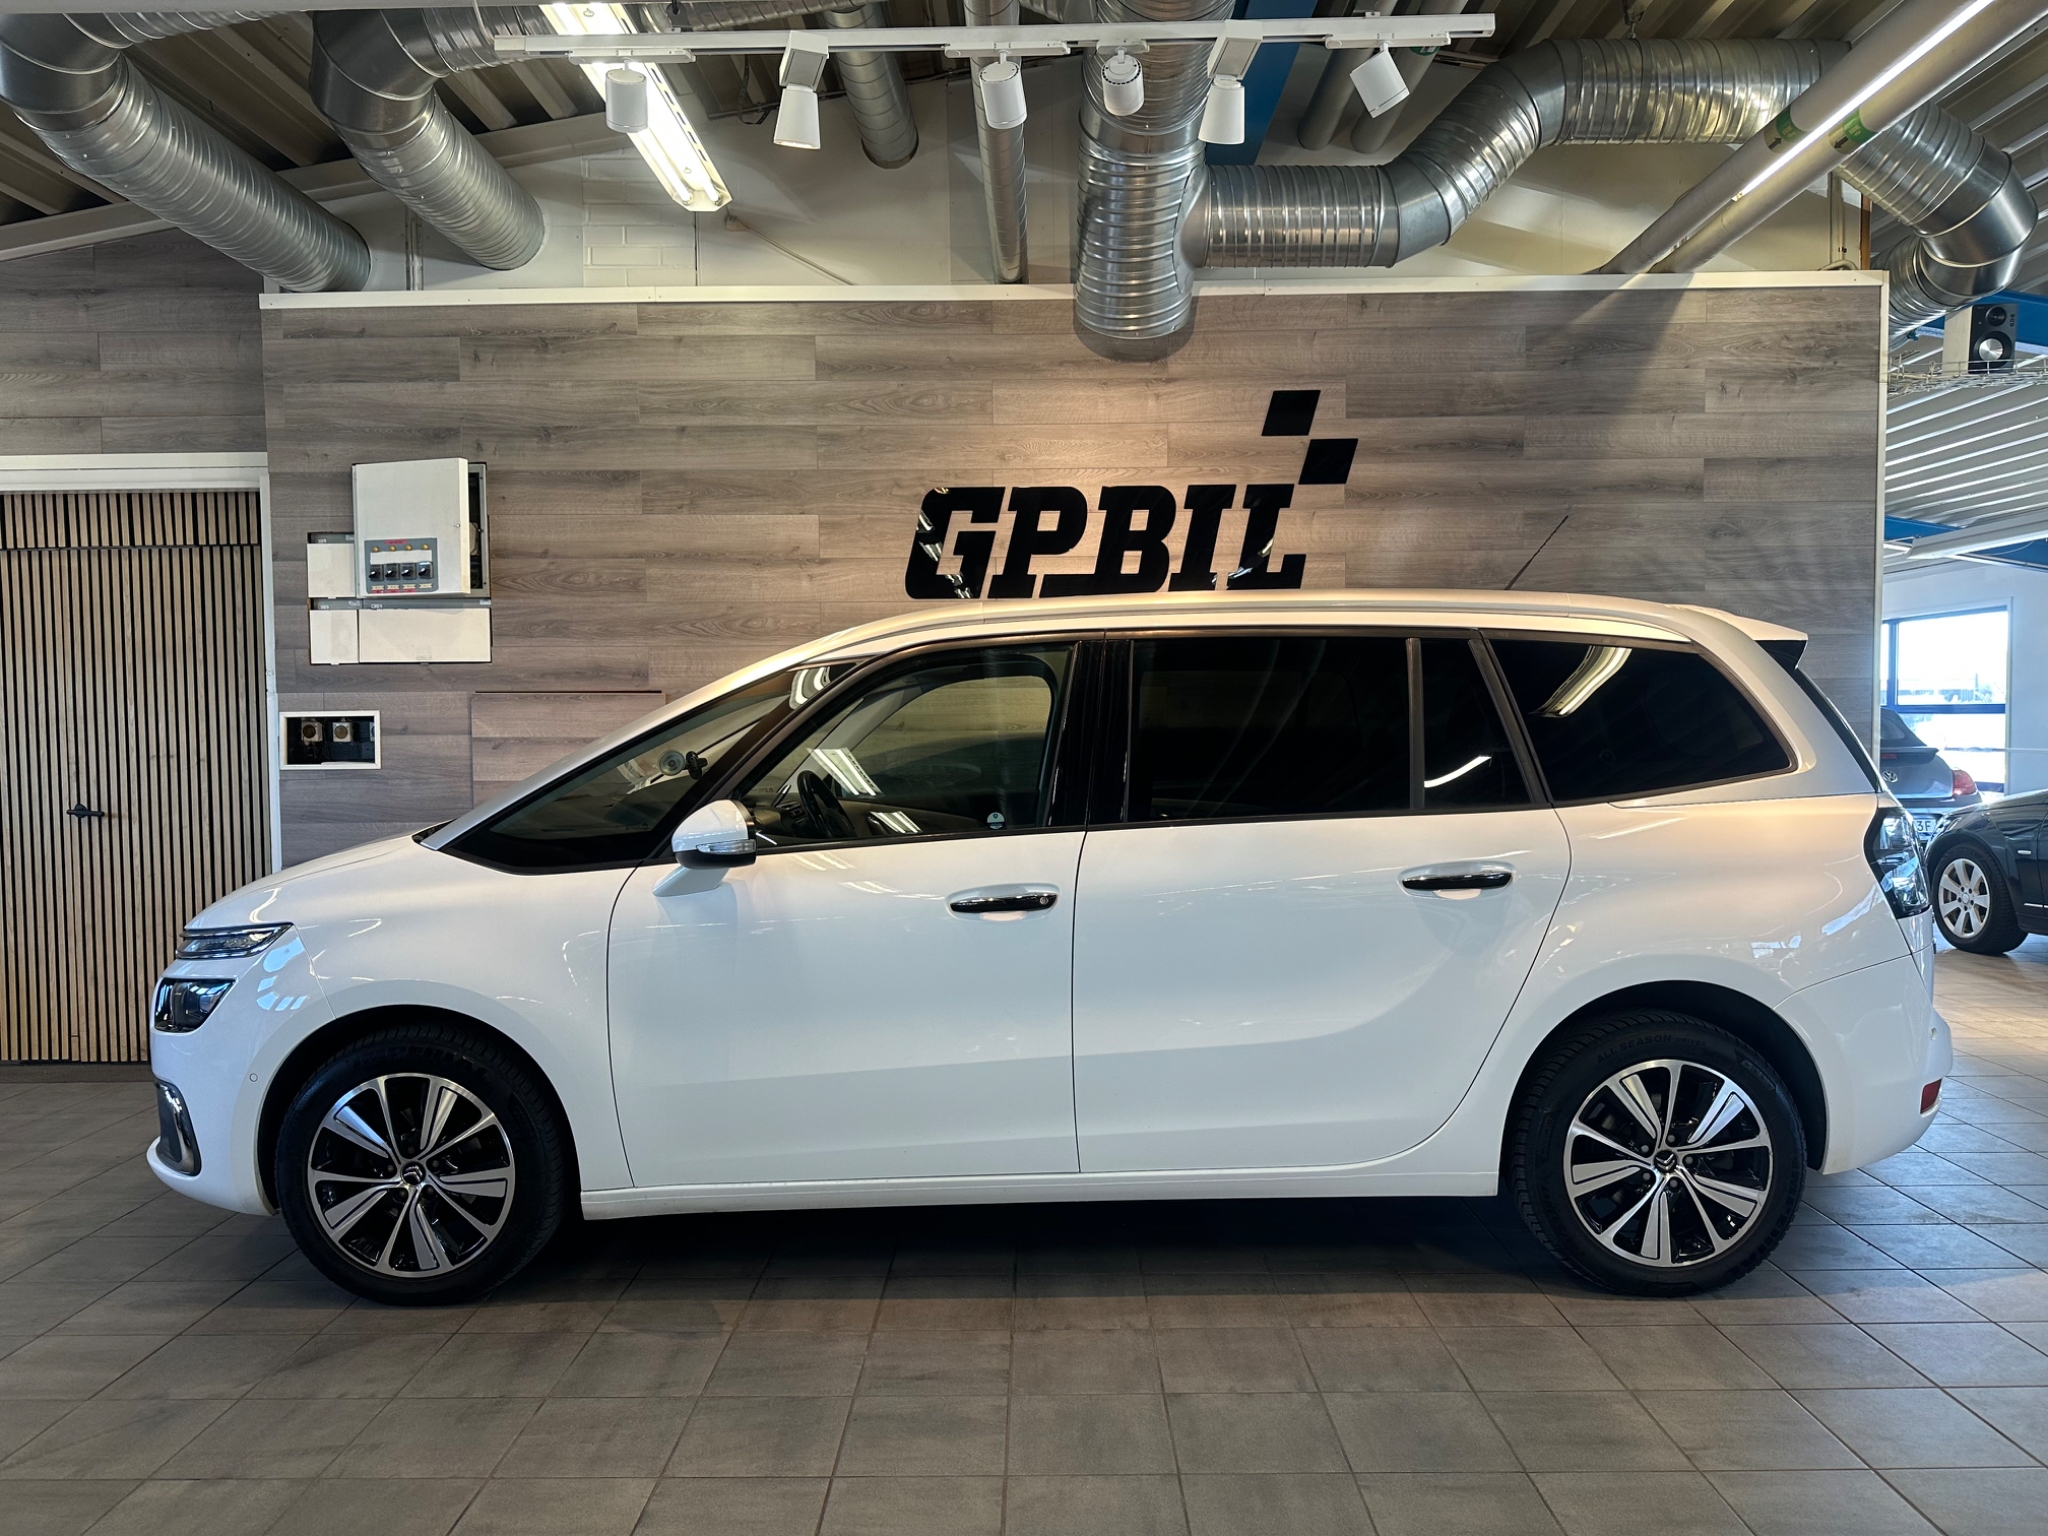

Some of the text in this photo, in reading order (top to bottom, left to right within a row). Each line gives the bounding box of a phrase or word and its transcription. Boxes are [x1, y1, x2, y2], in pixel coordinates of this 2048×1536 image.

[905, 483, 1306, 599] GPBIL
[1596, 1048, 1618, 1064] ALL
[1619, 1034, 1672, 1052] SEASON
